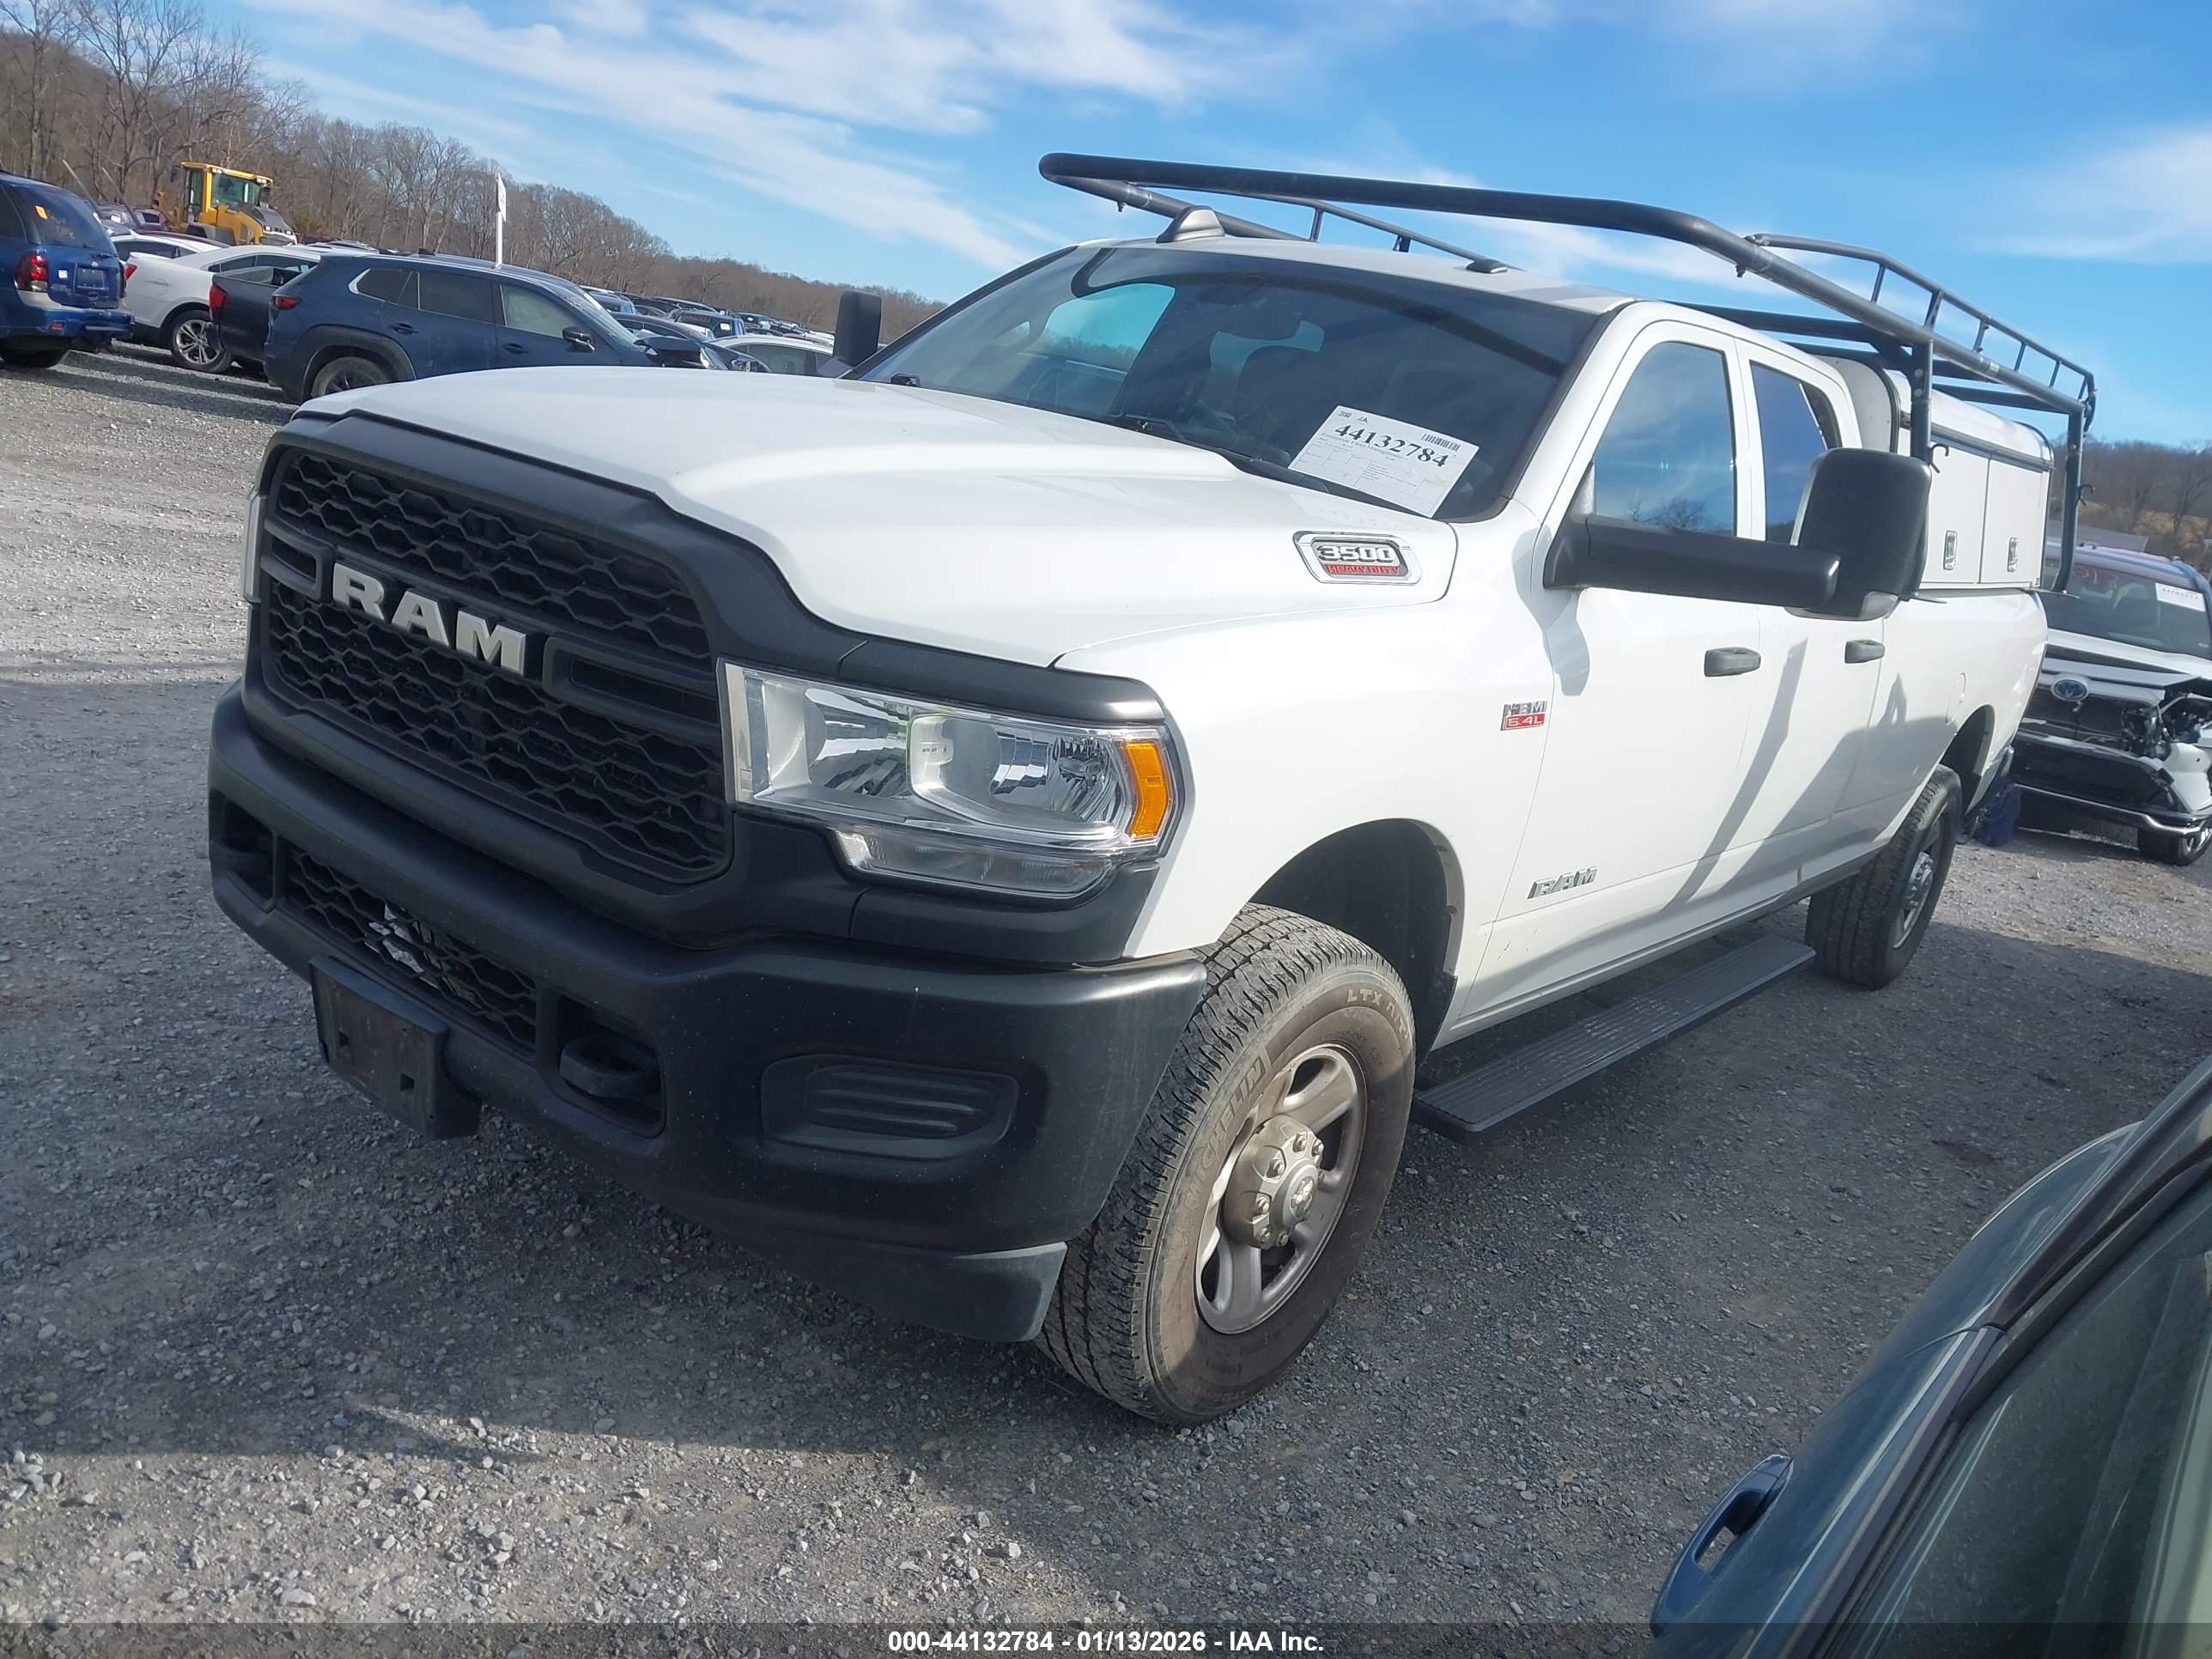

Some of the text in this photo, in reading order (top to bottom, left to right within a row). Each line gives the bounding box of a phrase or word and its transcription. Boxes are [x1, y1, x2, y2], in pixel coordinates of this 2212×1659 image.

[1334, 424, 1449, 467] 44132784
[1316, 545, 1396, 562] 3500
[333, 563, 526, 675] RAM
[1507, 714, 1543, 727] 6.4L
[1527, 867, 1598, 899] RAM
[1347, 989, 1382, 1006] LTX
